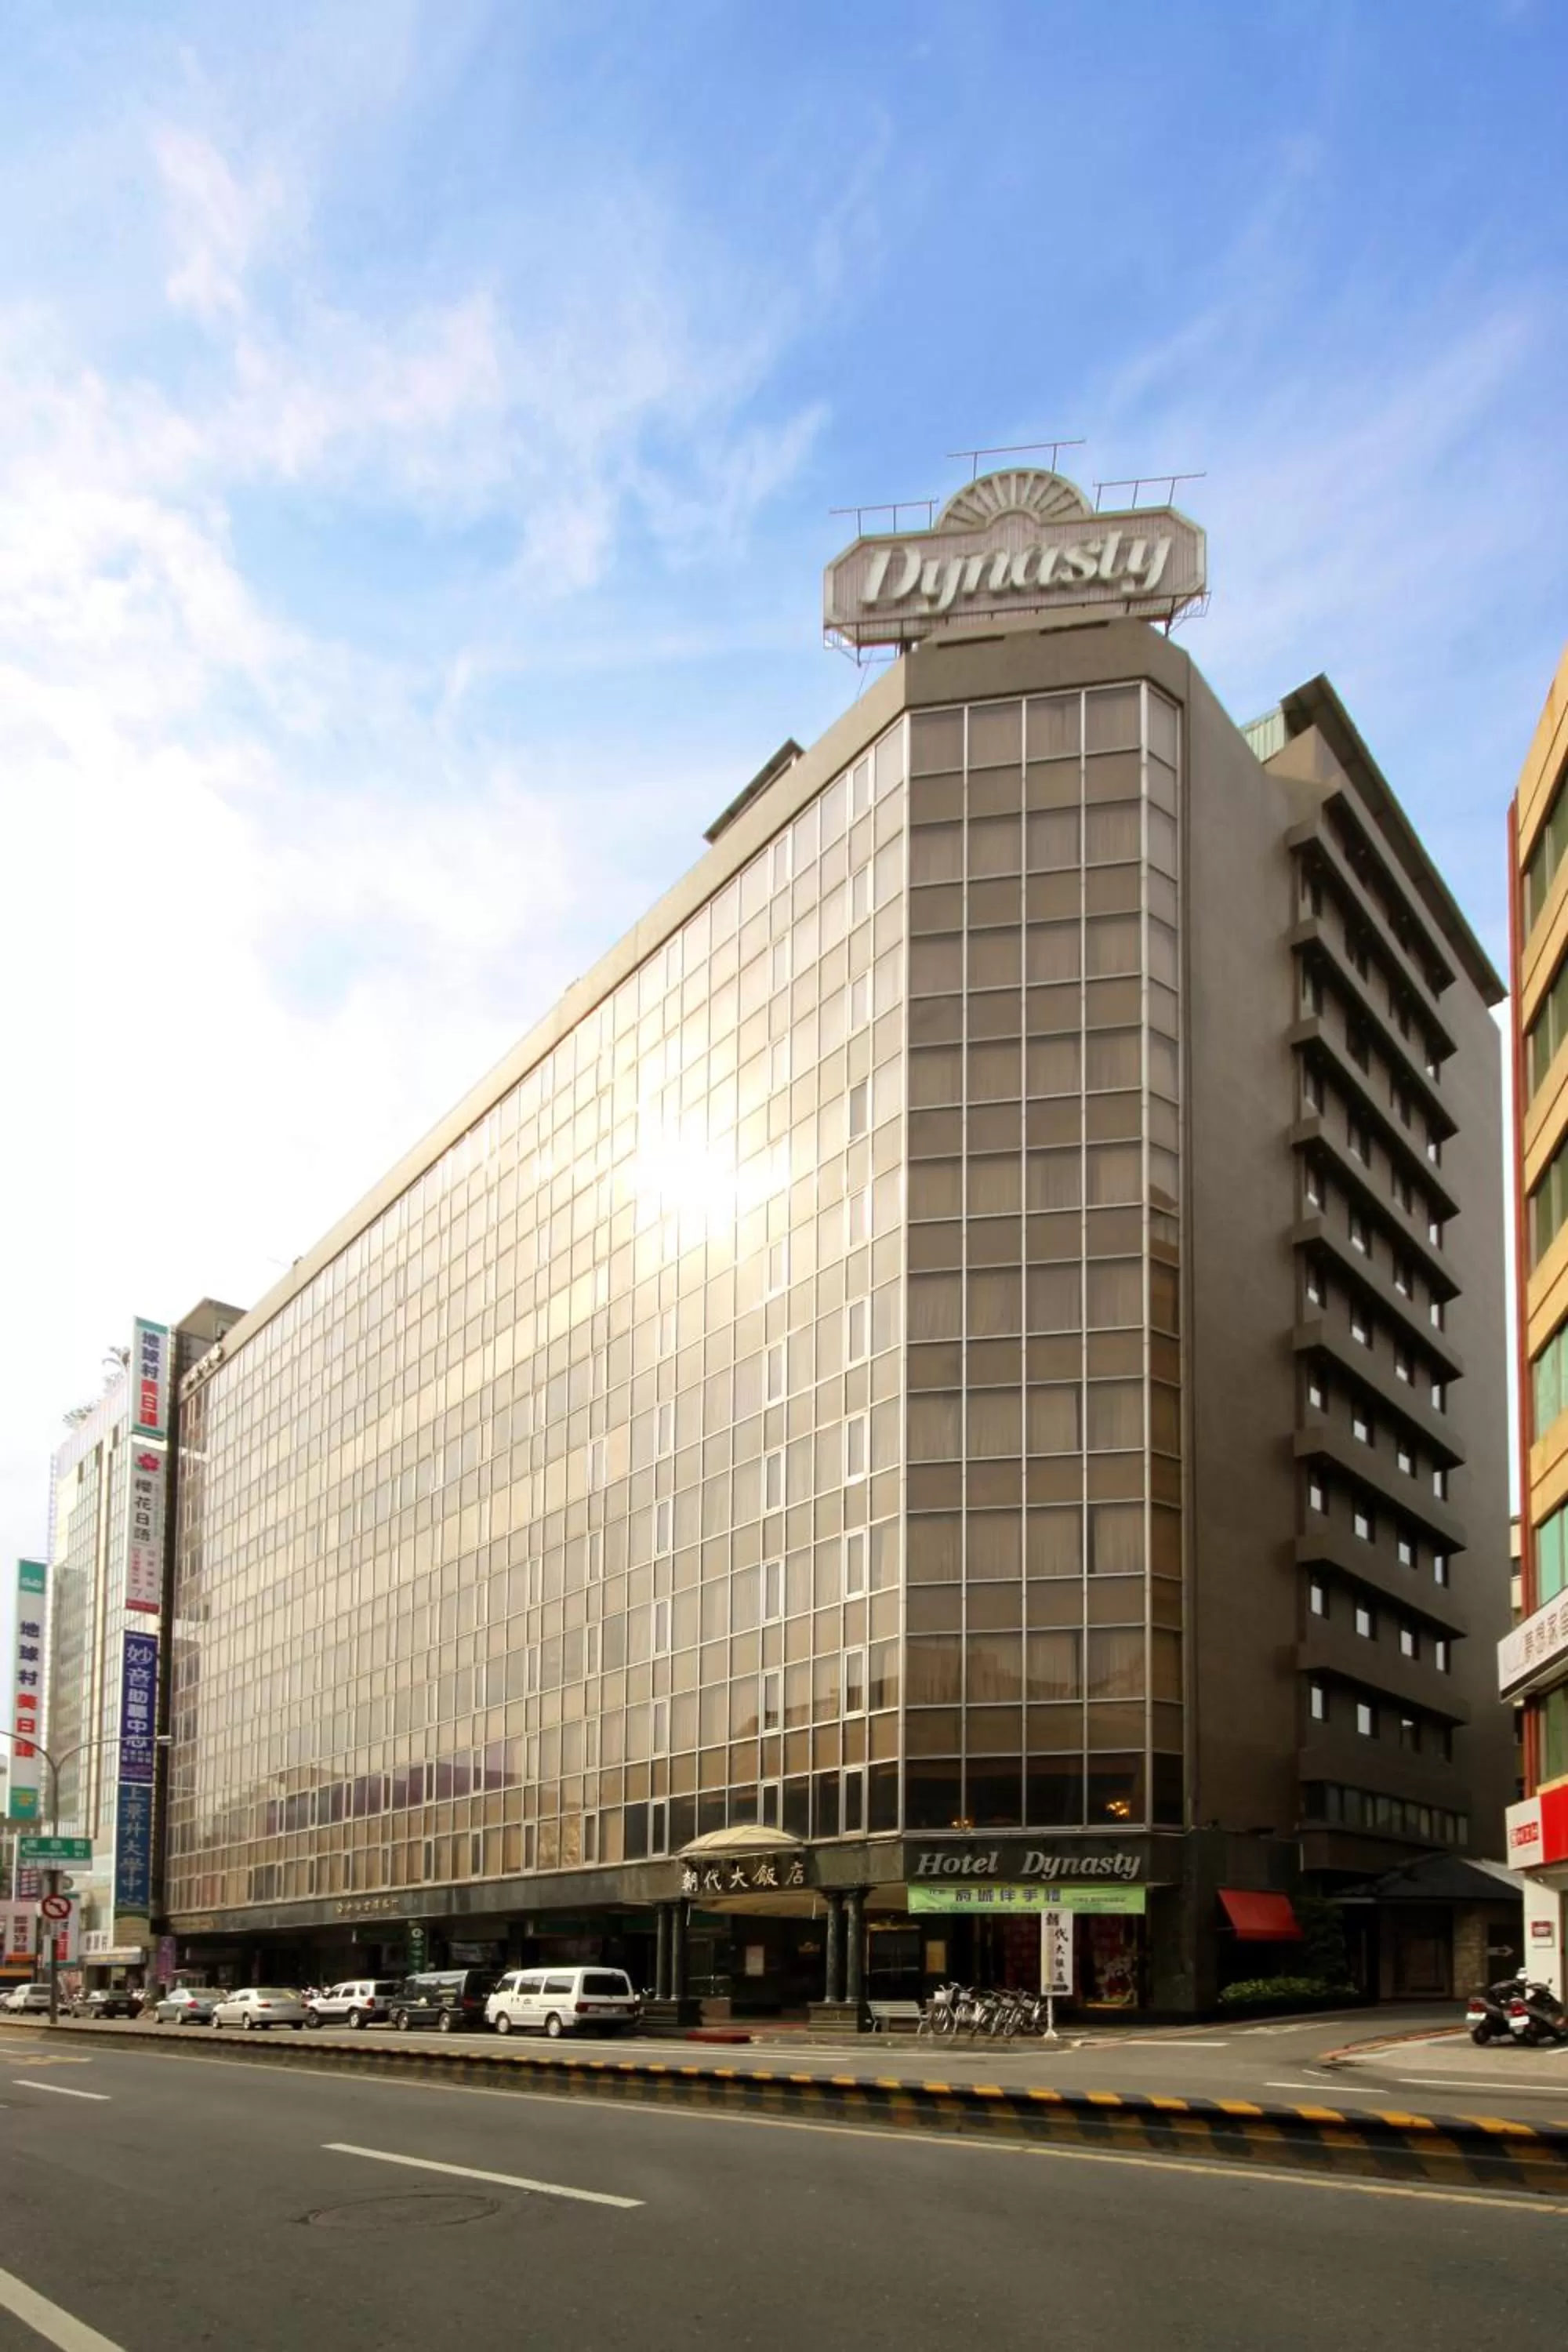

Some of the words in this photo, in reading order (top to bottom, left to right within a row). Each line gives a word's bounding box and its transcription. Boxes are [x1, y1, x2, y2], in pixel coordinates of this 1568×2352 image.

[861, 530, 1172, 615] Dynasty
[140, 1330, 160, 1427] 地球村日
[681, 1860, 804, 1892] 朝代大飯店
[916, 1851, 999, 1875] Hotel
[1021, 1851, 1142, 1880] Dynasty
